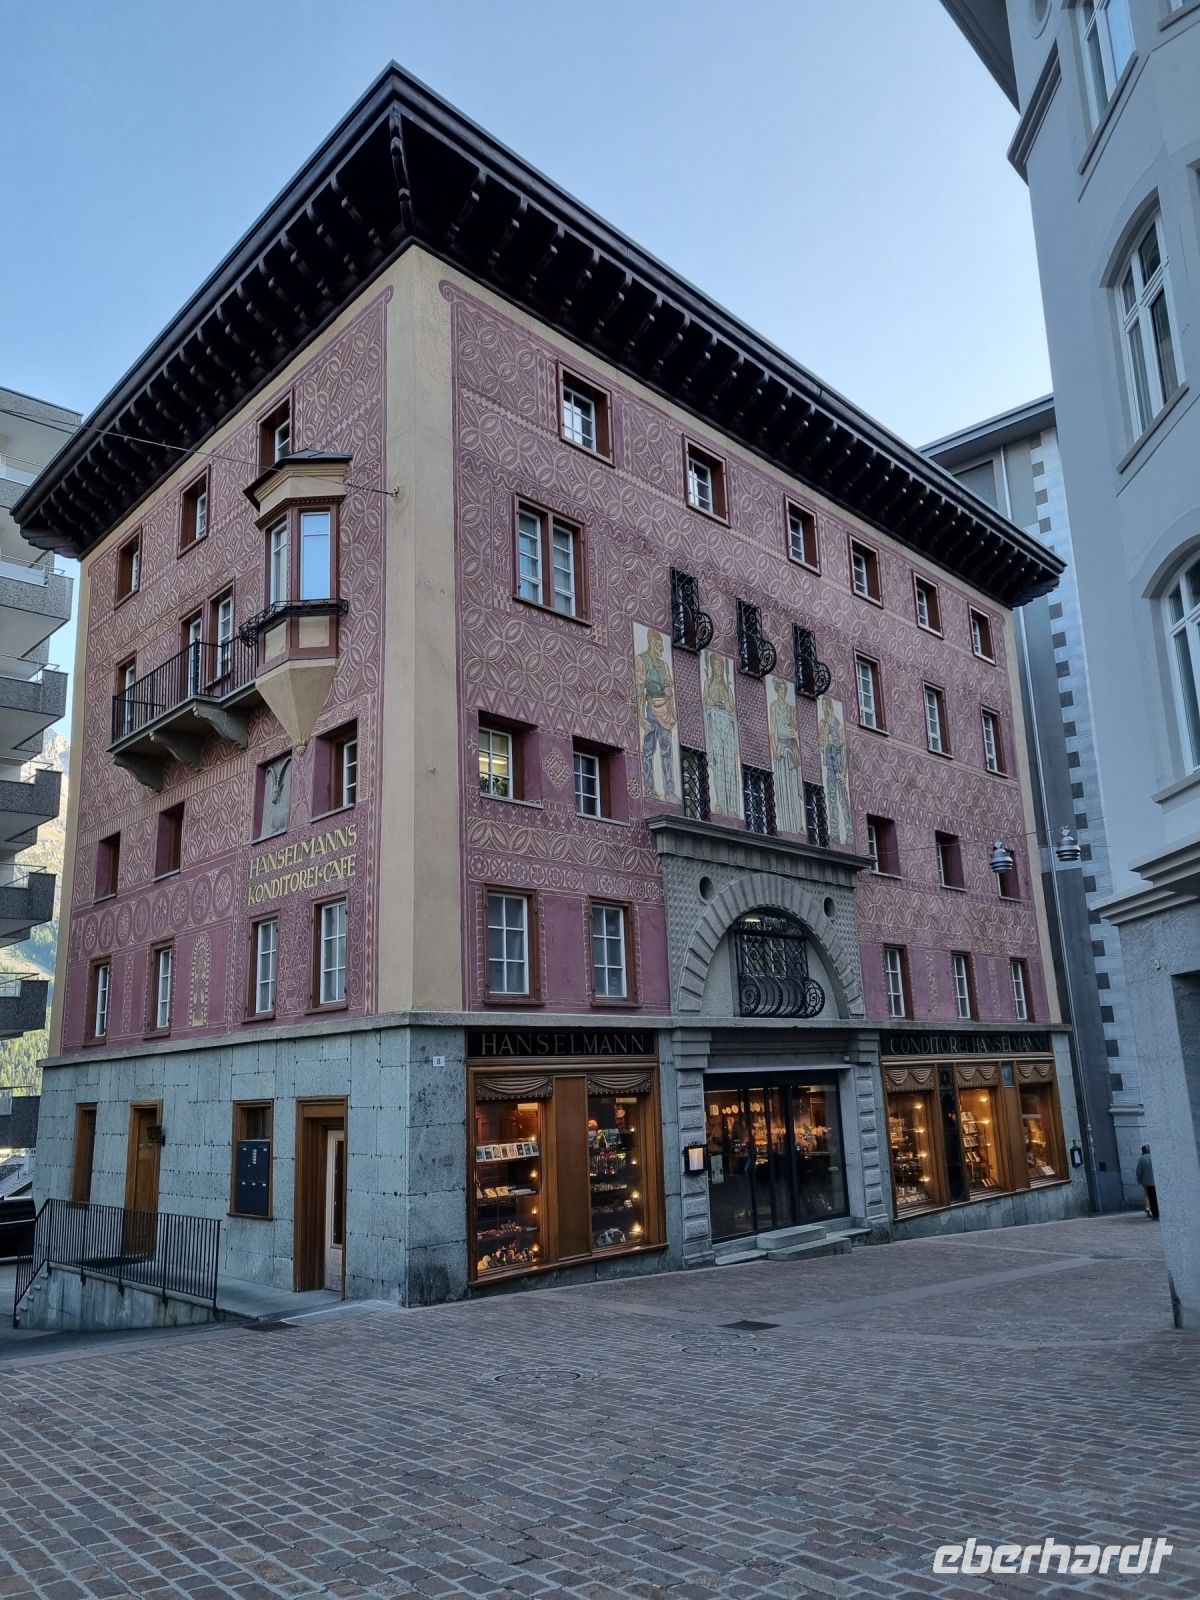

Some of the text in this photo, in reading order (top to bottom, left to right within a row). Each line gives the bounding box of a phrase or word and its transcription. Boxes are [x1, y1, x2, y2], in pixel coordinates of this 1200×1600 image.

[250, 823, 357, 879] HANSELMANNS
[481, 1033, 645, 1055] HANSELMANN
[890, 1036, 1043, 1054] CONDITOREI HANSELMANN
